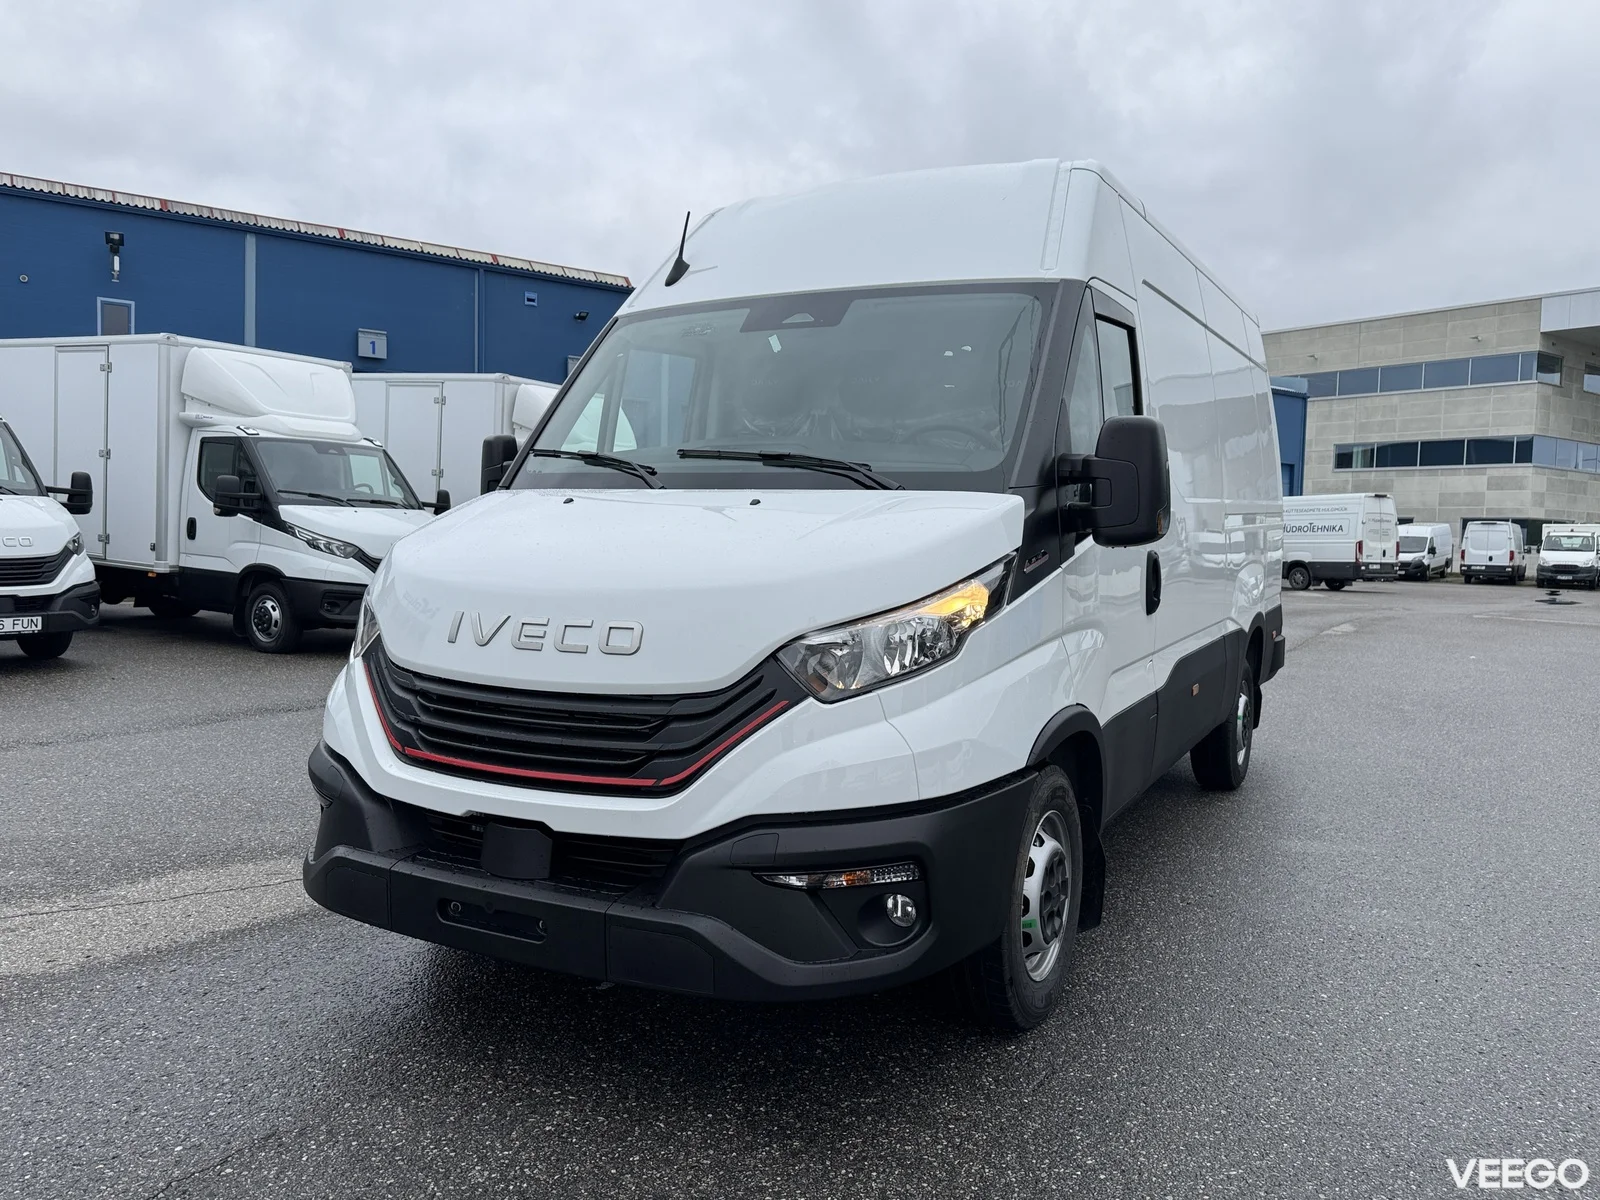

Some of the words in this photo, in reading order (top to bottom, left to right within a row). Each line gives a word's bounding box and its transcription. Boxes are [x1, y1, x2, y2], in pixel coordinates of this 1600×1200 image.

[369, 340, 376, 355] 1
[2, 536, 33, 548] CO
[12, 618, 39, 630] FUN
[447, 611, 644, 656] IVECO
